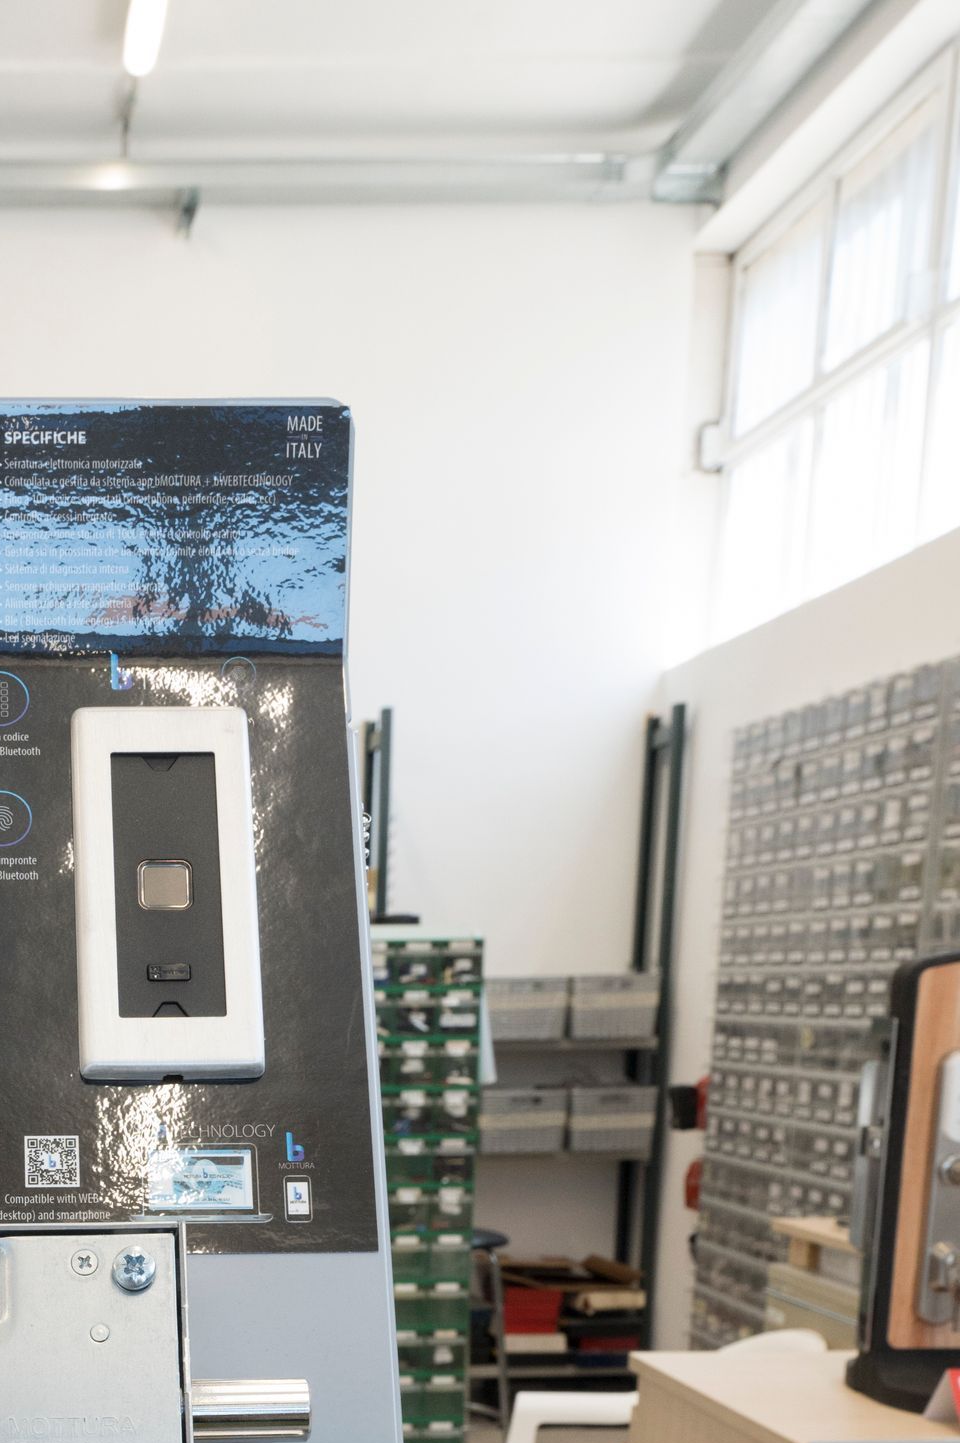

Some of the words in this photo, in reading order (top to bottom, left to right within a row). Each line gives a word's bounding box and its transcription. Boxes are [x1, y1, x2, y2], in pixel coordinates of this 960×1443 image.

[287, 415, 323, 431] MADE
[4, 430, 87, 444] SPECIFICHE
[286, 442, 322, 458] ITALY
[4, 457, 43, 469] Serratura
[45, 457, 90, 469] elettronica
[92, 457, 142, 470] motorizzata
[4, 475, 50, 487] Controllata
[52, 478, 58, 487] e
[59, 475, 88, 491] gestita
[90, 475, 101, 487] da
[102, 475, 134, 488] sistema
[135, 477, 153, 491] app
[155, 475, 201, 487] bMOTTURA
[213, 475, 293, 487] bWEBTECHNOLOGY
[4, 563, 38, 575] Sistema
[40, 563, 48, 575] di
[49, 563, 97, 578] diagnostica
[99, 564, 129, 575] interna
[4, 581, 38, 592] Sensore
[99, 599, 132, 609] batteria
[5, 616, 18, 626] Ble
[26, 615, 66, 627] Bluetooth
[3, 732, 29, 742] codice
[0, 746, 41, 756] Bluetooth
[279, 1162, 315, 1170] MOTTURA
[4, 1194, 53, 1208] Compatible
[55, 1194, 77, 1205] with
[79, 1194, 100, 1205] WEB
[38, 1210, 54, 1221] and
[56, 1210, 111, 1222] smartphone
[8, 1415, 137, 1437] MOTTURA
